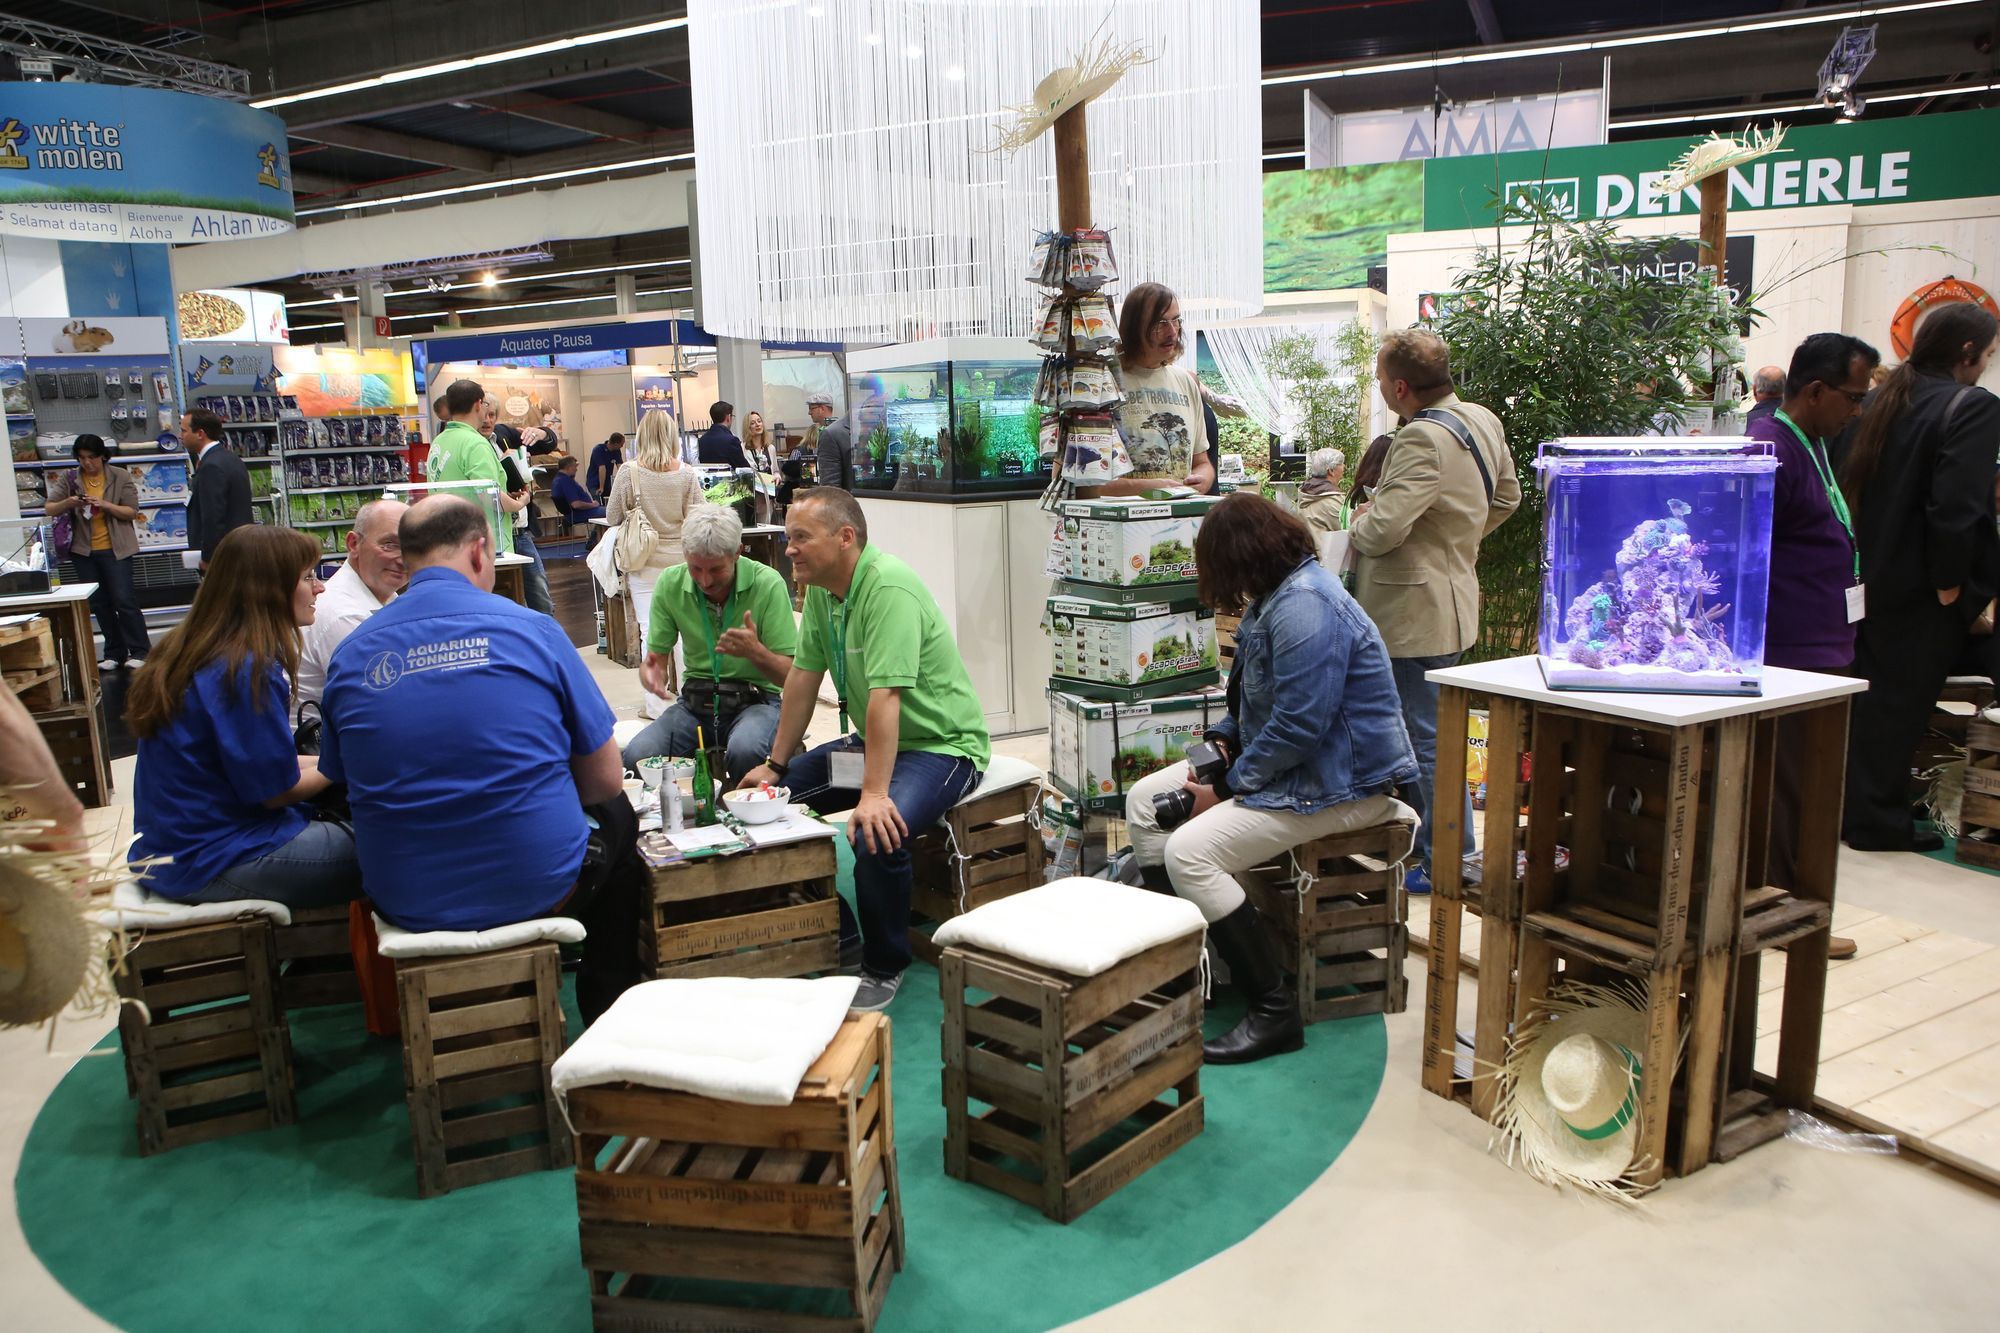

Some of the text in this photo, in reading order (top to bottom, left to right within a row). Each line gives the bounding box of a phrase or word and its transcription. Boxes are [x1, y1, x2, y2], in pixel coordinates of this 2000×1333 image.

[33, 118, 120, 147] witte
[1398, 108, 1537, 160] AMA
[37, 147, 124, 170] molen
[10, 213, 65, 230] Selamat
[69, 220, 118, 236] datang
[128, 212, 183, 222] Bienvenue
[190, 215, 253, 237] Ahlan
[129, 226, 173, 240] Aloha
[500, 333, 593, 354] Aquatec Pausa
[1145, 560, 1190, 575] scaper's
[407, 637, 489, 659] AQUARIUM
[407, 647, 489, 669] TONNDORF
[1104, 708, 1135, 716] scper's
[1155, 722, 1201, 735] scaper's
[1661, 745, 1689, 949] Wein aus deschen Landen
[777, 921, 796, 933] aus
[799, 916, 825, 931] Wein
[1432, 907, 1447, 953] Landen
[1159, 1025, 1175, 1041] aus
[1428, 1018, 1440, 1040] aus
[1424, 1042, 1439, 1069] Wein
[658, 1185, 749, 1206] deutschen
[752, 1190, 785, 1204] aus
[792, 1191, 834, 1211] Wein
